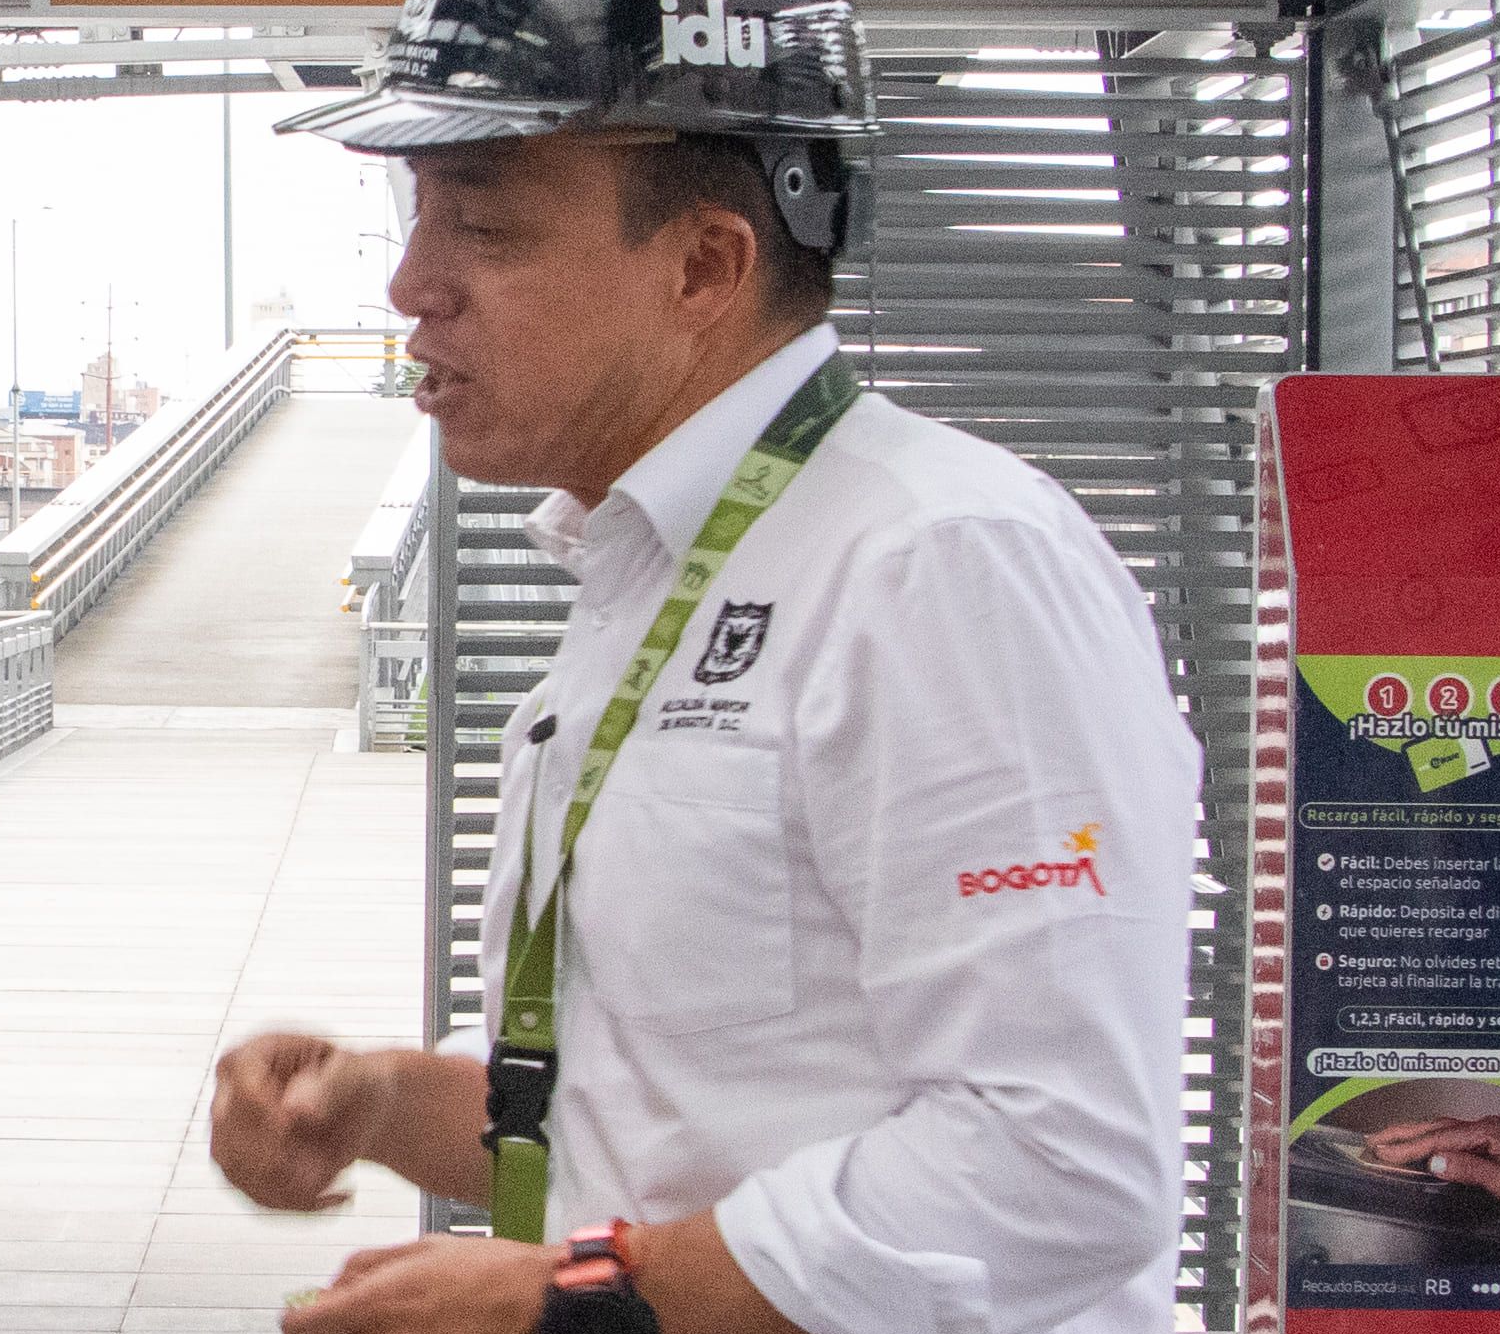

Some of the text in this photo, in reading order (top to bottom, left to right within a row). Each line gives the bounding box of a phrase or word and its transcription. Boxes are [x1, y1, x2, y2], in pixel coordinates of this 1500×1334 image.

[1378, 685, 1395, 709] 1
[1440, 685, 1459, 710] 2
[1349, 714, 1428, 741] ¡Hazlo
[1434, 715, 1461, 738] tú
[1306, 808, 1368, 825] Recarga
[1371, 808, 1410, 824] fácil,
[1413, 809, 1464, 827] rápido
[1466, 813, 1476, 827] y
[1340, 855, 1381, 870] Fácil:
[1384, 856, 1430, 871] Debes
[1433, 856, 1490, 871] insertar
[1339, 875, 1481, 891] el espacio señalado
[1339, 904, 1397, 921] Rápido:
[1400, 905, 1466, 921] Deposita
[1468, 906, 1482, 919] el
[1338, 925, 1489, 941] que quieres recargar
[1338, 954, 1397, 971] Seguro:
[1400, 955, 1421, 969] No
[1425, 955, 1477, 969] olvides
[1338, 975, 1387, 990] tarjeta
[1390, 974, 1404, 988] al
[1406, 973, 1466, 988] finalizar
[1469, 975, 1482, 989] la
[1349, 1012, 1381, 1027] 1,2,3
[1384, 1012, 1426, 1028] ¡Fácil,
[1428, 1013, 1475, 1028] rápido
[1477, 1017, 1486, 1029] y
[1315, 1051, 1375, 1074] ¡Hazlo
[1376, 1052, 1399, 1072] tú
[1401, 1052, 1466, 1073] mismo
[1466, 1056, 1500, 1073] con
[1425, 1279, 1452, 1296] RB
